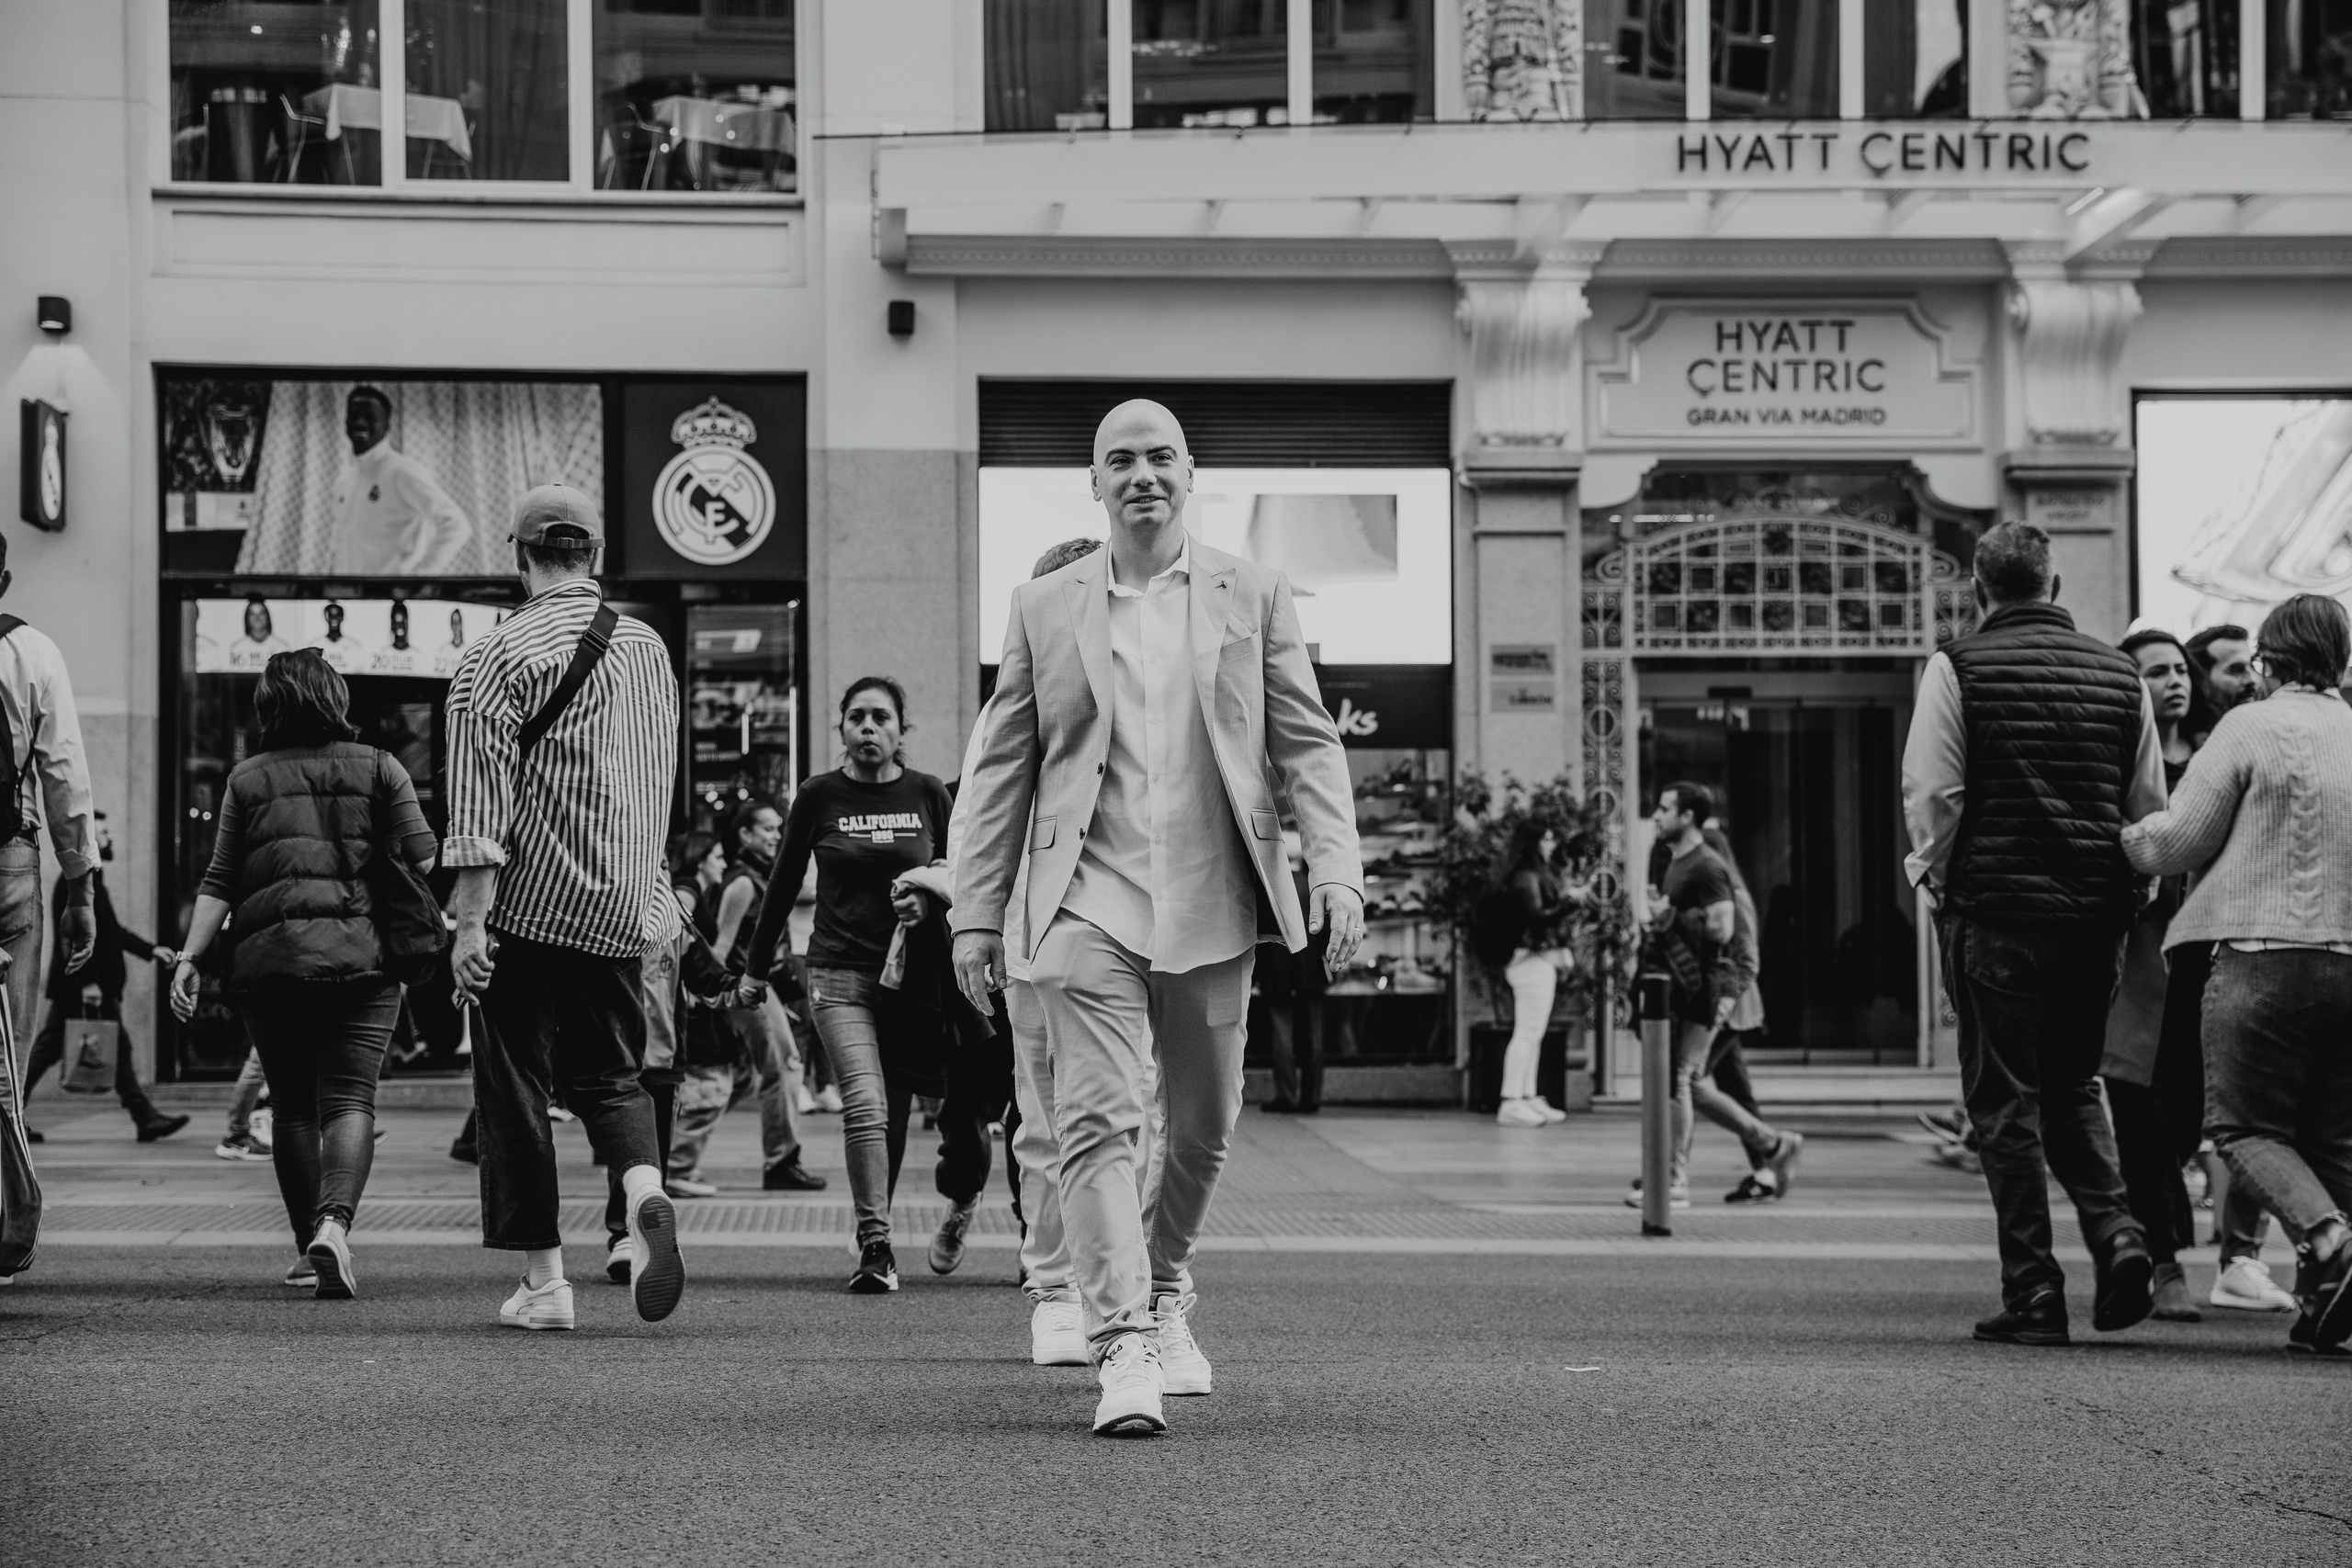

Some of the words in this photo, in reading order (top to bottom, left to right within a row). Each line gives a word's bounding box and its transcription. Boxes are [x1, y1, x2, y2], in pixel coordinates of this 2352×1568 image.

[1677, 133, 1839, 172] HYATT
[1715, 319, 1856, 354] HYATT
[1687, 407, 1750, 425] GRAN
[1757, 408, 1792, 425] VIA
[1801, 407, 1886, 425] MADRID
[1337, 697, 1378, 736] ks
[838, 813, 922, 831] CALIFORNIA
